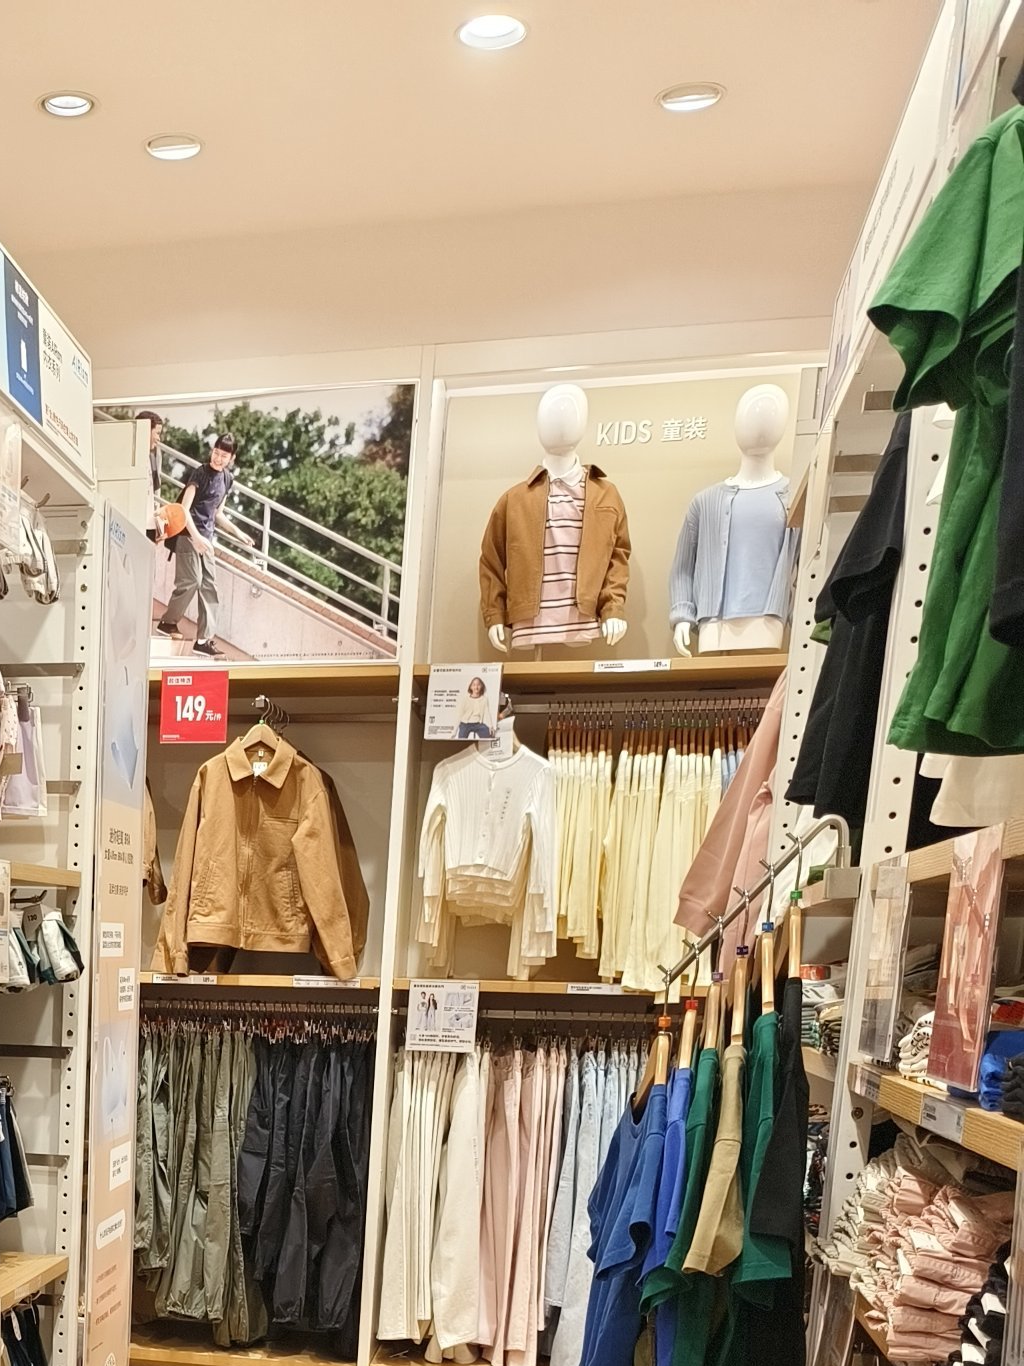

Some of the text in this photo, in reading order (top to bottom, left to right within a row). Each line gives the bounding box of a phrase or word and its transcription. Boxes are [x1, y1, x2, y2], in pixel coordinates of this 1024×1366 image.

[596, 416, 708, 446] KIDS 童装
[175, 695, 222, 722] 149 元/件
